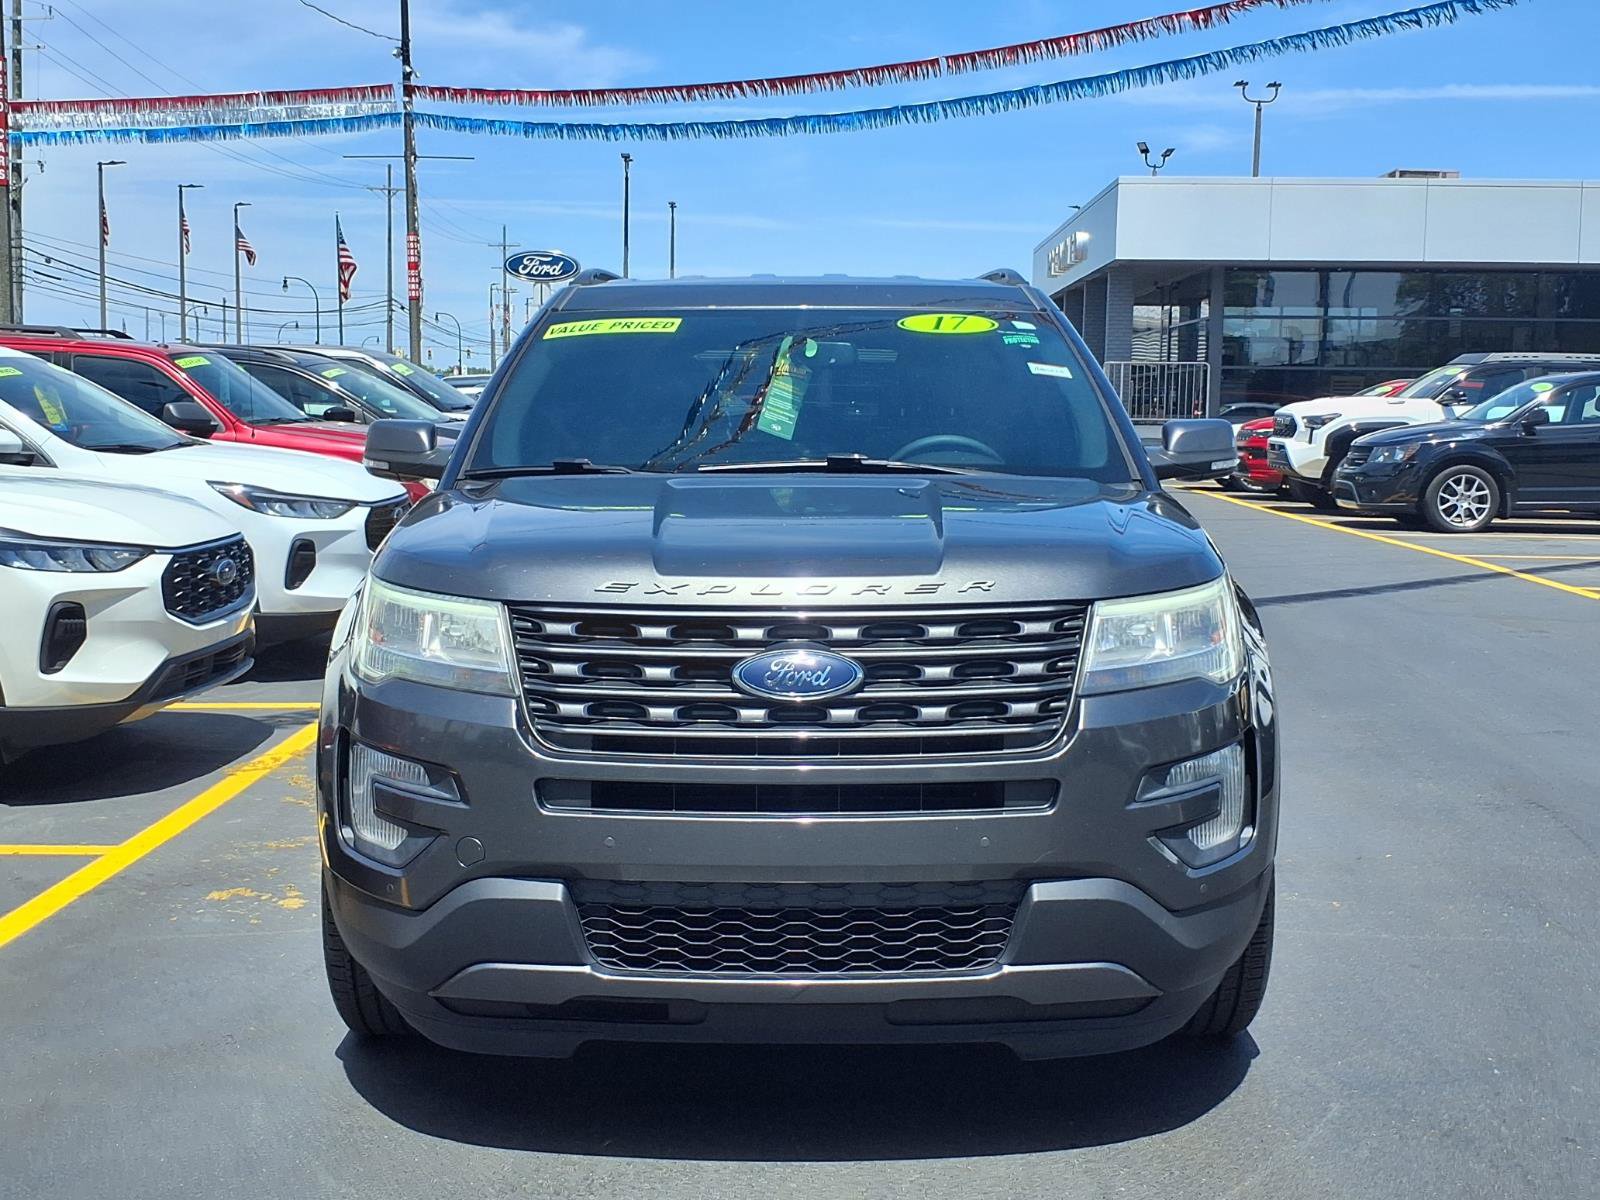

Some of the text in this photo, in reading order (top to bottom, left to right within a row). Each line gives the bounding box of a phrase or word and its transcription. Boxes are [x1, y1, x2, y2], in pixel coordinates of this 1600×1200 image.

[518, 255, 563, 276] Ford
[550, 320, 676, 336] VALUE PRICED
[931, 315, 969, 331] 17
[594, 581, 996, 596] EXPLORER
[764, 658, 831, 687] Ford
